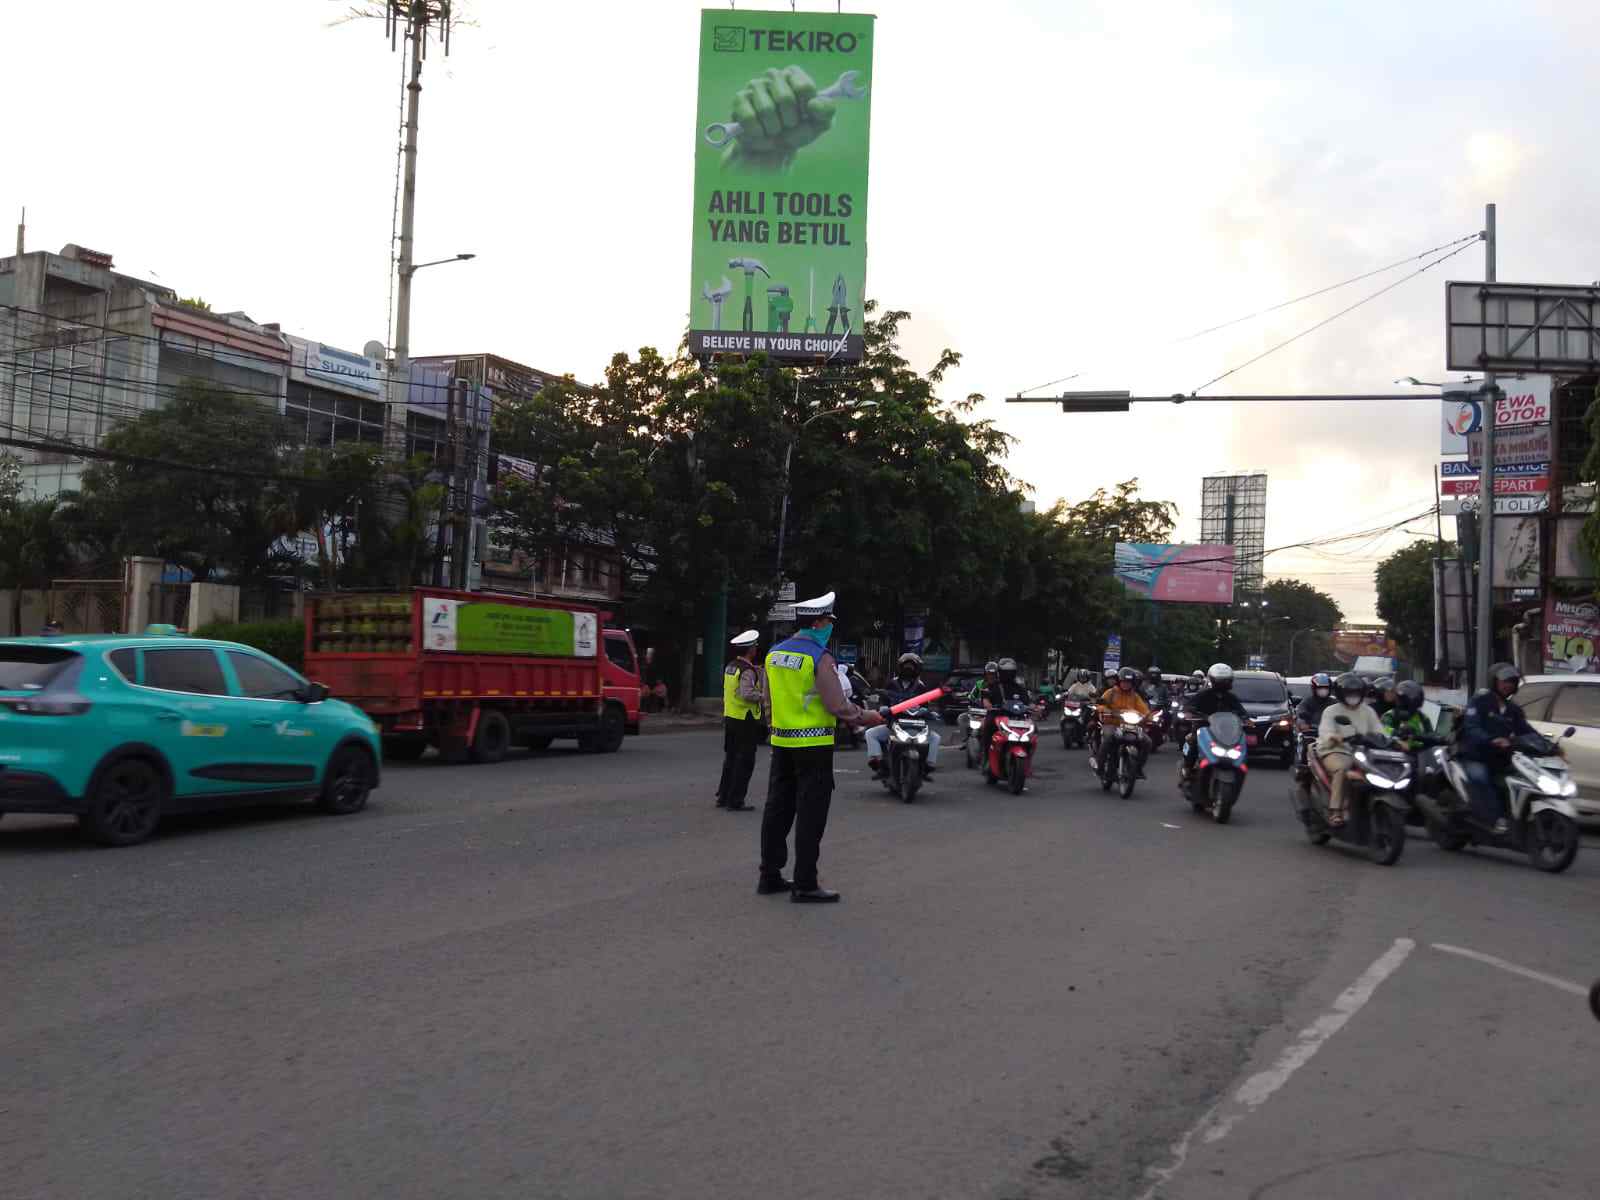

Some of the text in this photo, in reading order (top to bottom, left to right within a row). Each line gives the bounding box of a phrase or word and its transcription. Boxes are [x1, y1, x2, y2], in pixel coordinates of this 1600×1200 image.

[749, 30, 857, 52] TEKIRO
[708, 190, 853, 217] AHLI TOOLS
[708, 219, 850, 246] YANG BETUL
[702, 335, 848, 352] BELIEVE IN YOUR CHOICE
[321, 360, 370, 381] SUZUKI
[1496, 394, 1536, 410] EWA
[1496, 406, 1546, 423] OTOR
[1495, 463, 1549, 472] ERVICE
[1456, 479, 1535, 493] SPAEPART
